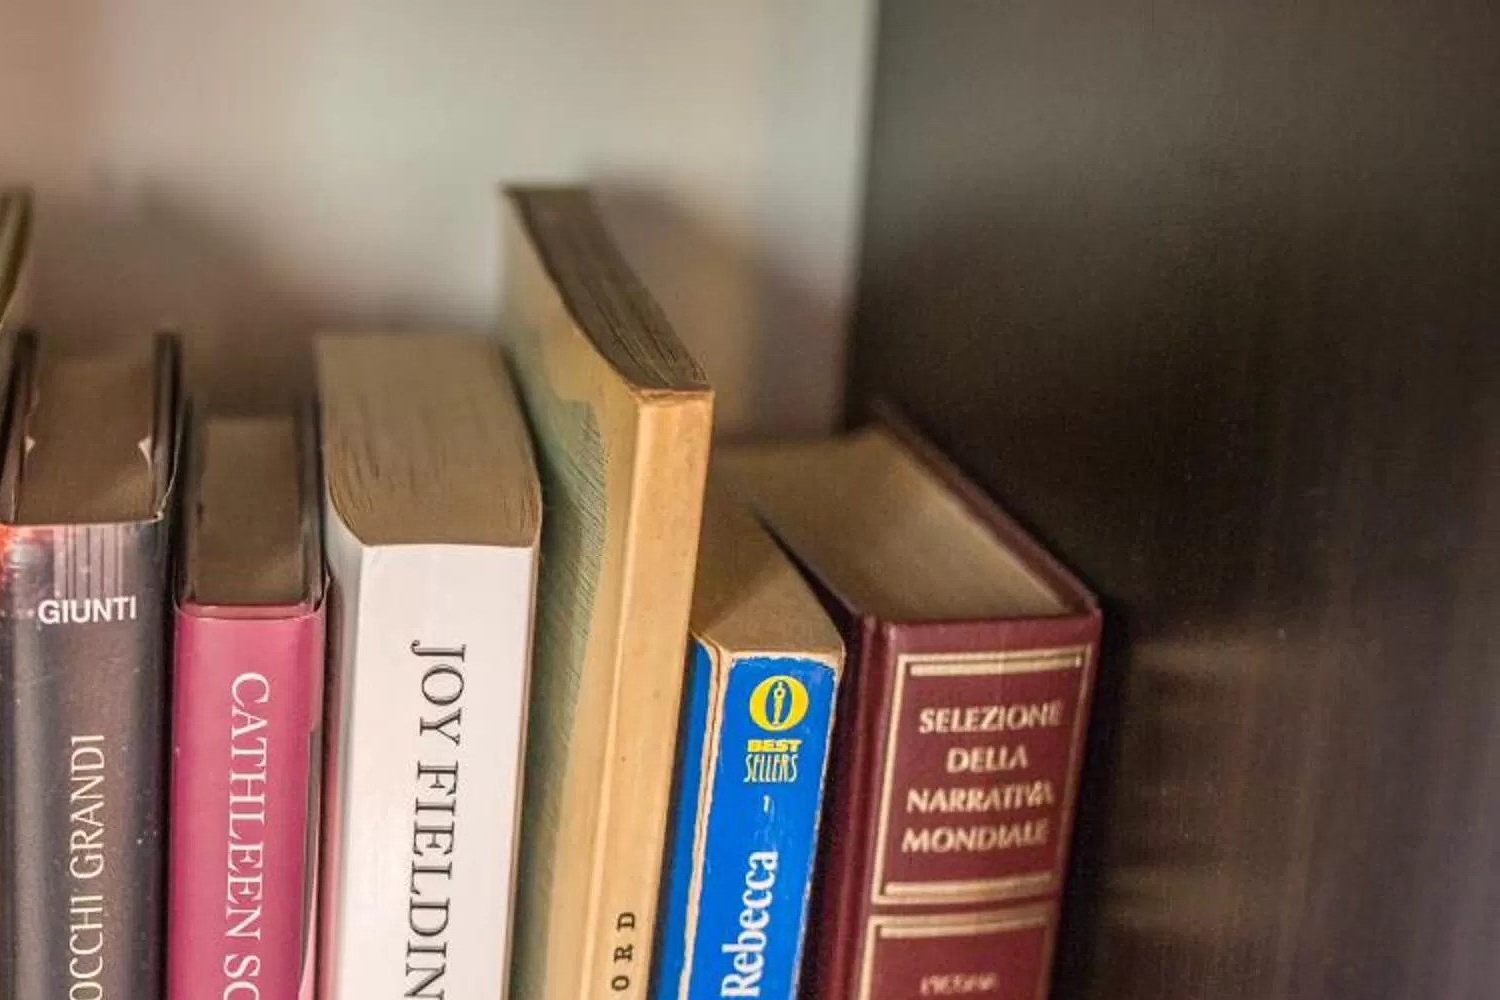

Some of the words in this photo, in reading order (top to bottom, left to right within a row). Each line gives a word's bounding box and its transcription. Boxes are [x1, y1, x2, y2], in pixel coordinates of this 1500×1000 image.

[38, 596, 136, 624] GIUNTI
[410, 640, 466, 746] JOY
[919, 700, 1065, 734] SELEZIONE
[748, 739, 802, 753] BEST
[947, 744, 1029, 773] DELLA
[743, 754, 798, 783] SELLERS
[69, 735, 104, 880] GRANDI
[225, 672, 270, 940] CATHLEEN
[906, 779, 1055, 814] NARRATIVA
[901, 817, 1049, 853] MONDIALE
[720, 849, 778, 998] Rebecca
